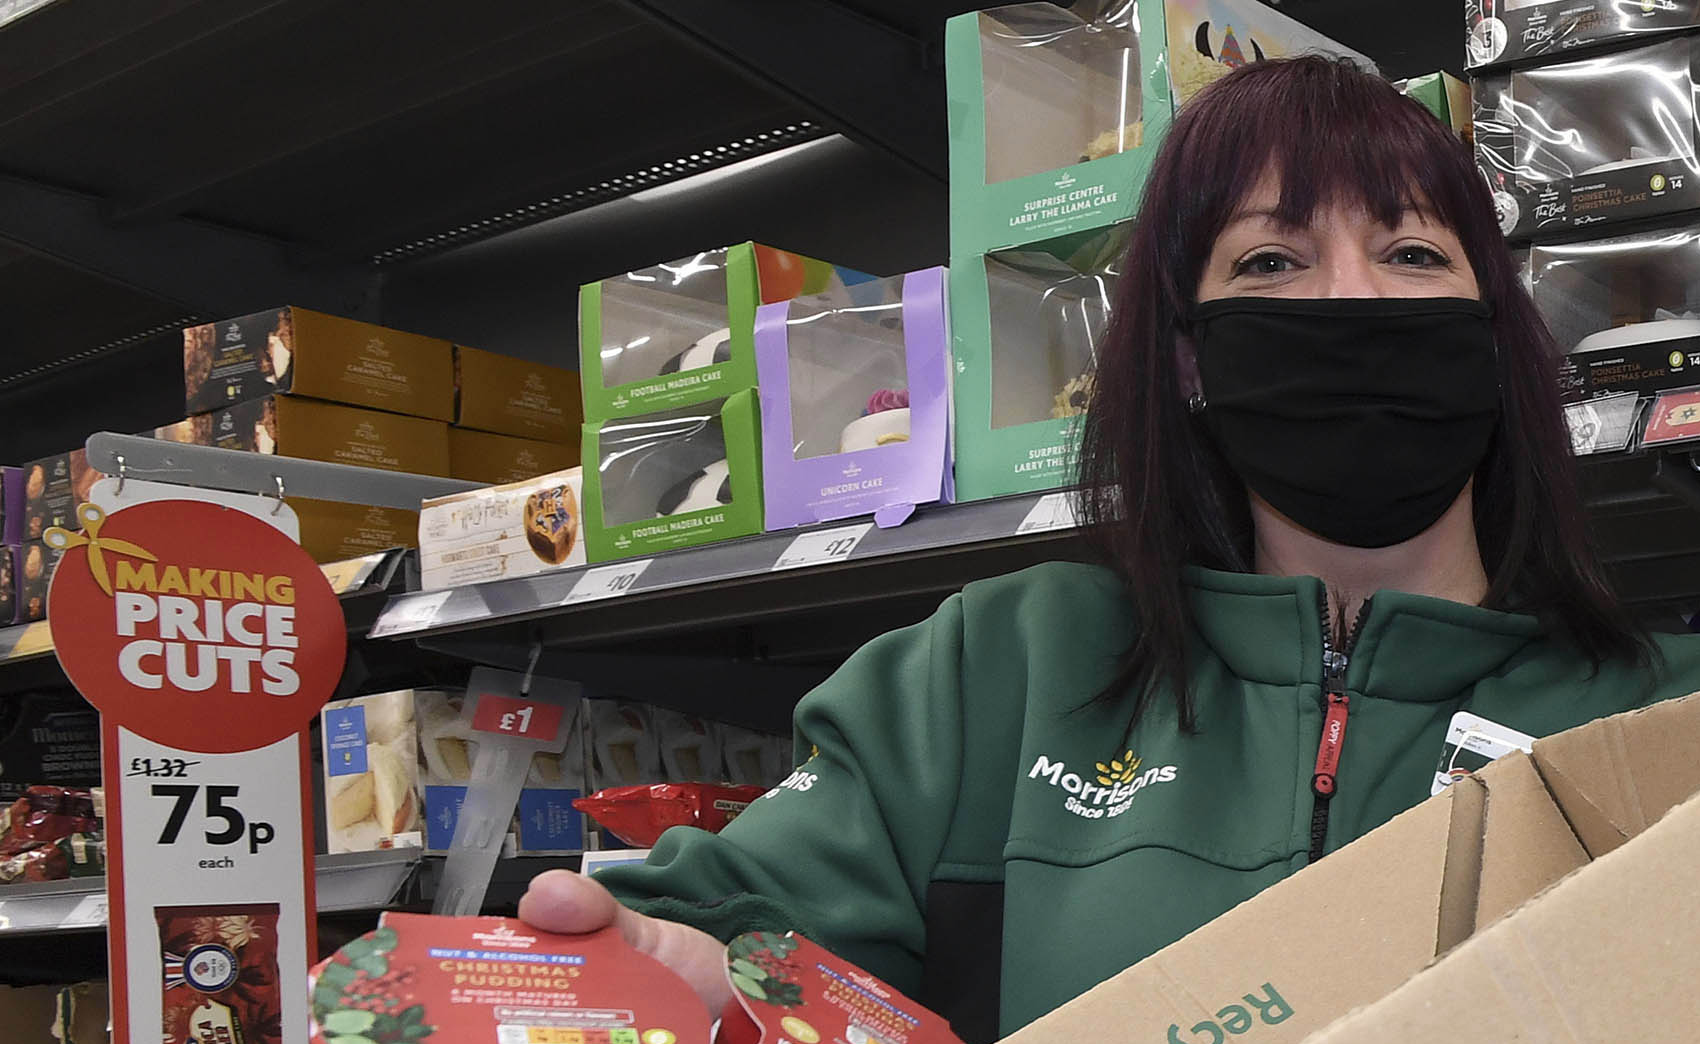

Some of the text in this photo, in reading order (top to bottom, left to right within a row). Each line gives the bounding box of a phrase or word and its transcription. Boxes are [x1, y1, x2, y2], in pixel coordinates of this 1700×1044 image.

[1009, 212, 1038, 226] LARRY
[1042, 207, 1059, 219] THE
[1061, 199, 1091, 215] LLAMA
[1094, 192, 1118, 206] CAKE
[1024, 184, 1104, 212] SURPRISE CENTRE
[1572, 192, 1647, 212] CHRISTMAS CAKE
[630, 370, 721, 398] FOOTBALL MADEIRA CAKE
[1014, 457, 1064, 473] LARRY THE
[820, 476, 883, 497] UNICORN CAKE
[632, 512, 725, 539] FOOTBALL MADEIRA CAKE
[824, 536, 856, 556] £12
[116, 560, 295, 604] MAKING
[607, 573, 636, 593] £10
[115, 591, 299, 648] PRICE
[118, 639, 300, 696] CUTS
[500, 706, 533, 733] £1
[1327, 719, 1341, 745] POPPY
[131, 757, 187, 778] £1.32
[1028, 755, 1178, 805] Morrisons
[151, 784, 275, 854] 75p
[198, 856, 234, 869] each
